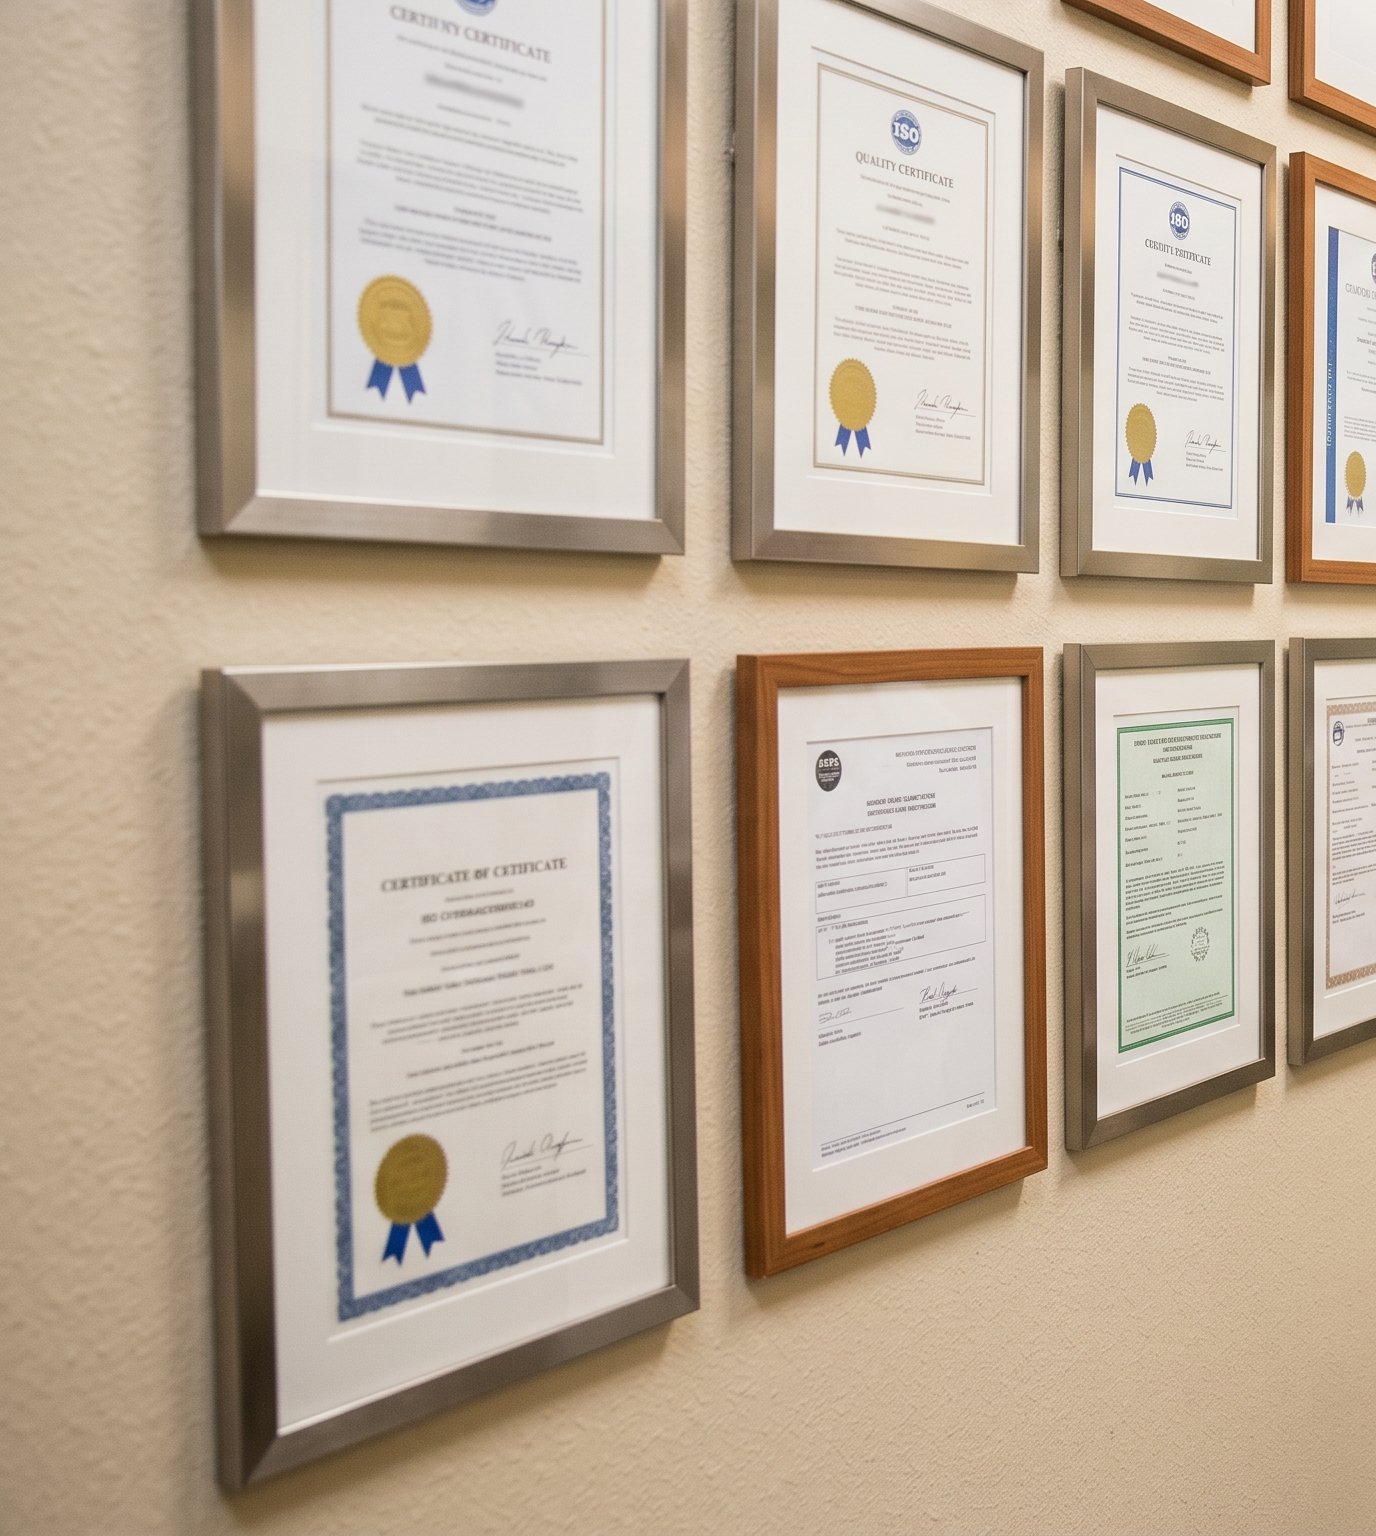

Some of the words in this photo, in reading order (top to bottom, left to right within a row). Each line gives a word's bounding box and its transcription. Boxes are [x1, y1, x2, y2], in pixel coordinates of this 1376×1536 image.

[464, 27, 551, 63] CERTIFICATE
[893, 121, 919, 144] ISO
[855, 151, 896, 171] QUALITY
[898, 164, 954, 188] CERTIFICATE
[381, 869, 470, 893] CERTIFICATE
